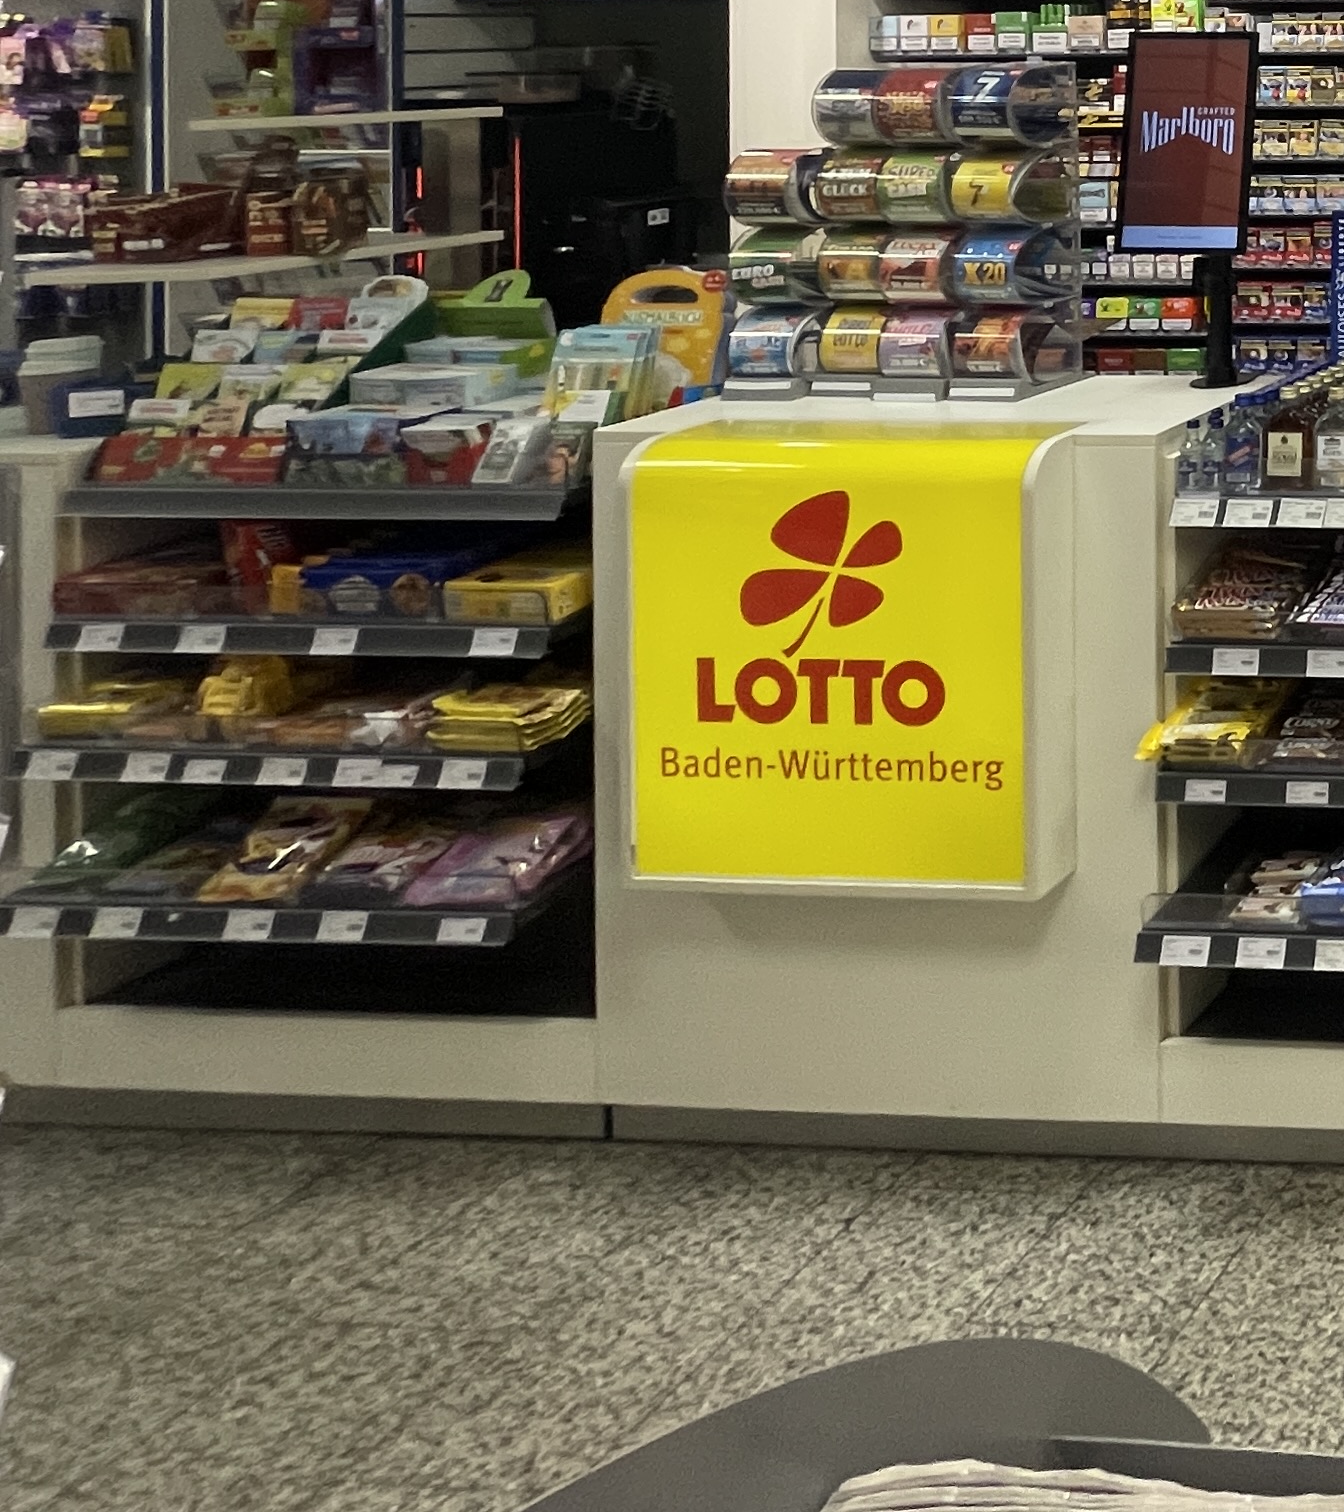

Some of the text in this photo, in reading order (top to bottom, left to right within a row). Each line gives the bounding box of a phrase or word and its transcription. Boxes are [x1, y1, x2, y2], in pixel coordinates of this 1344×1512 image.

[1141, 107, 1234, 155] Marlboro
[1198, 107, 1235, 115] CRAFTED
[697, 657, 946, 726] LOTTO
[661, 747, 1004, 791] Baden-Württemberg
